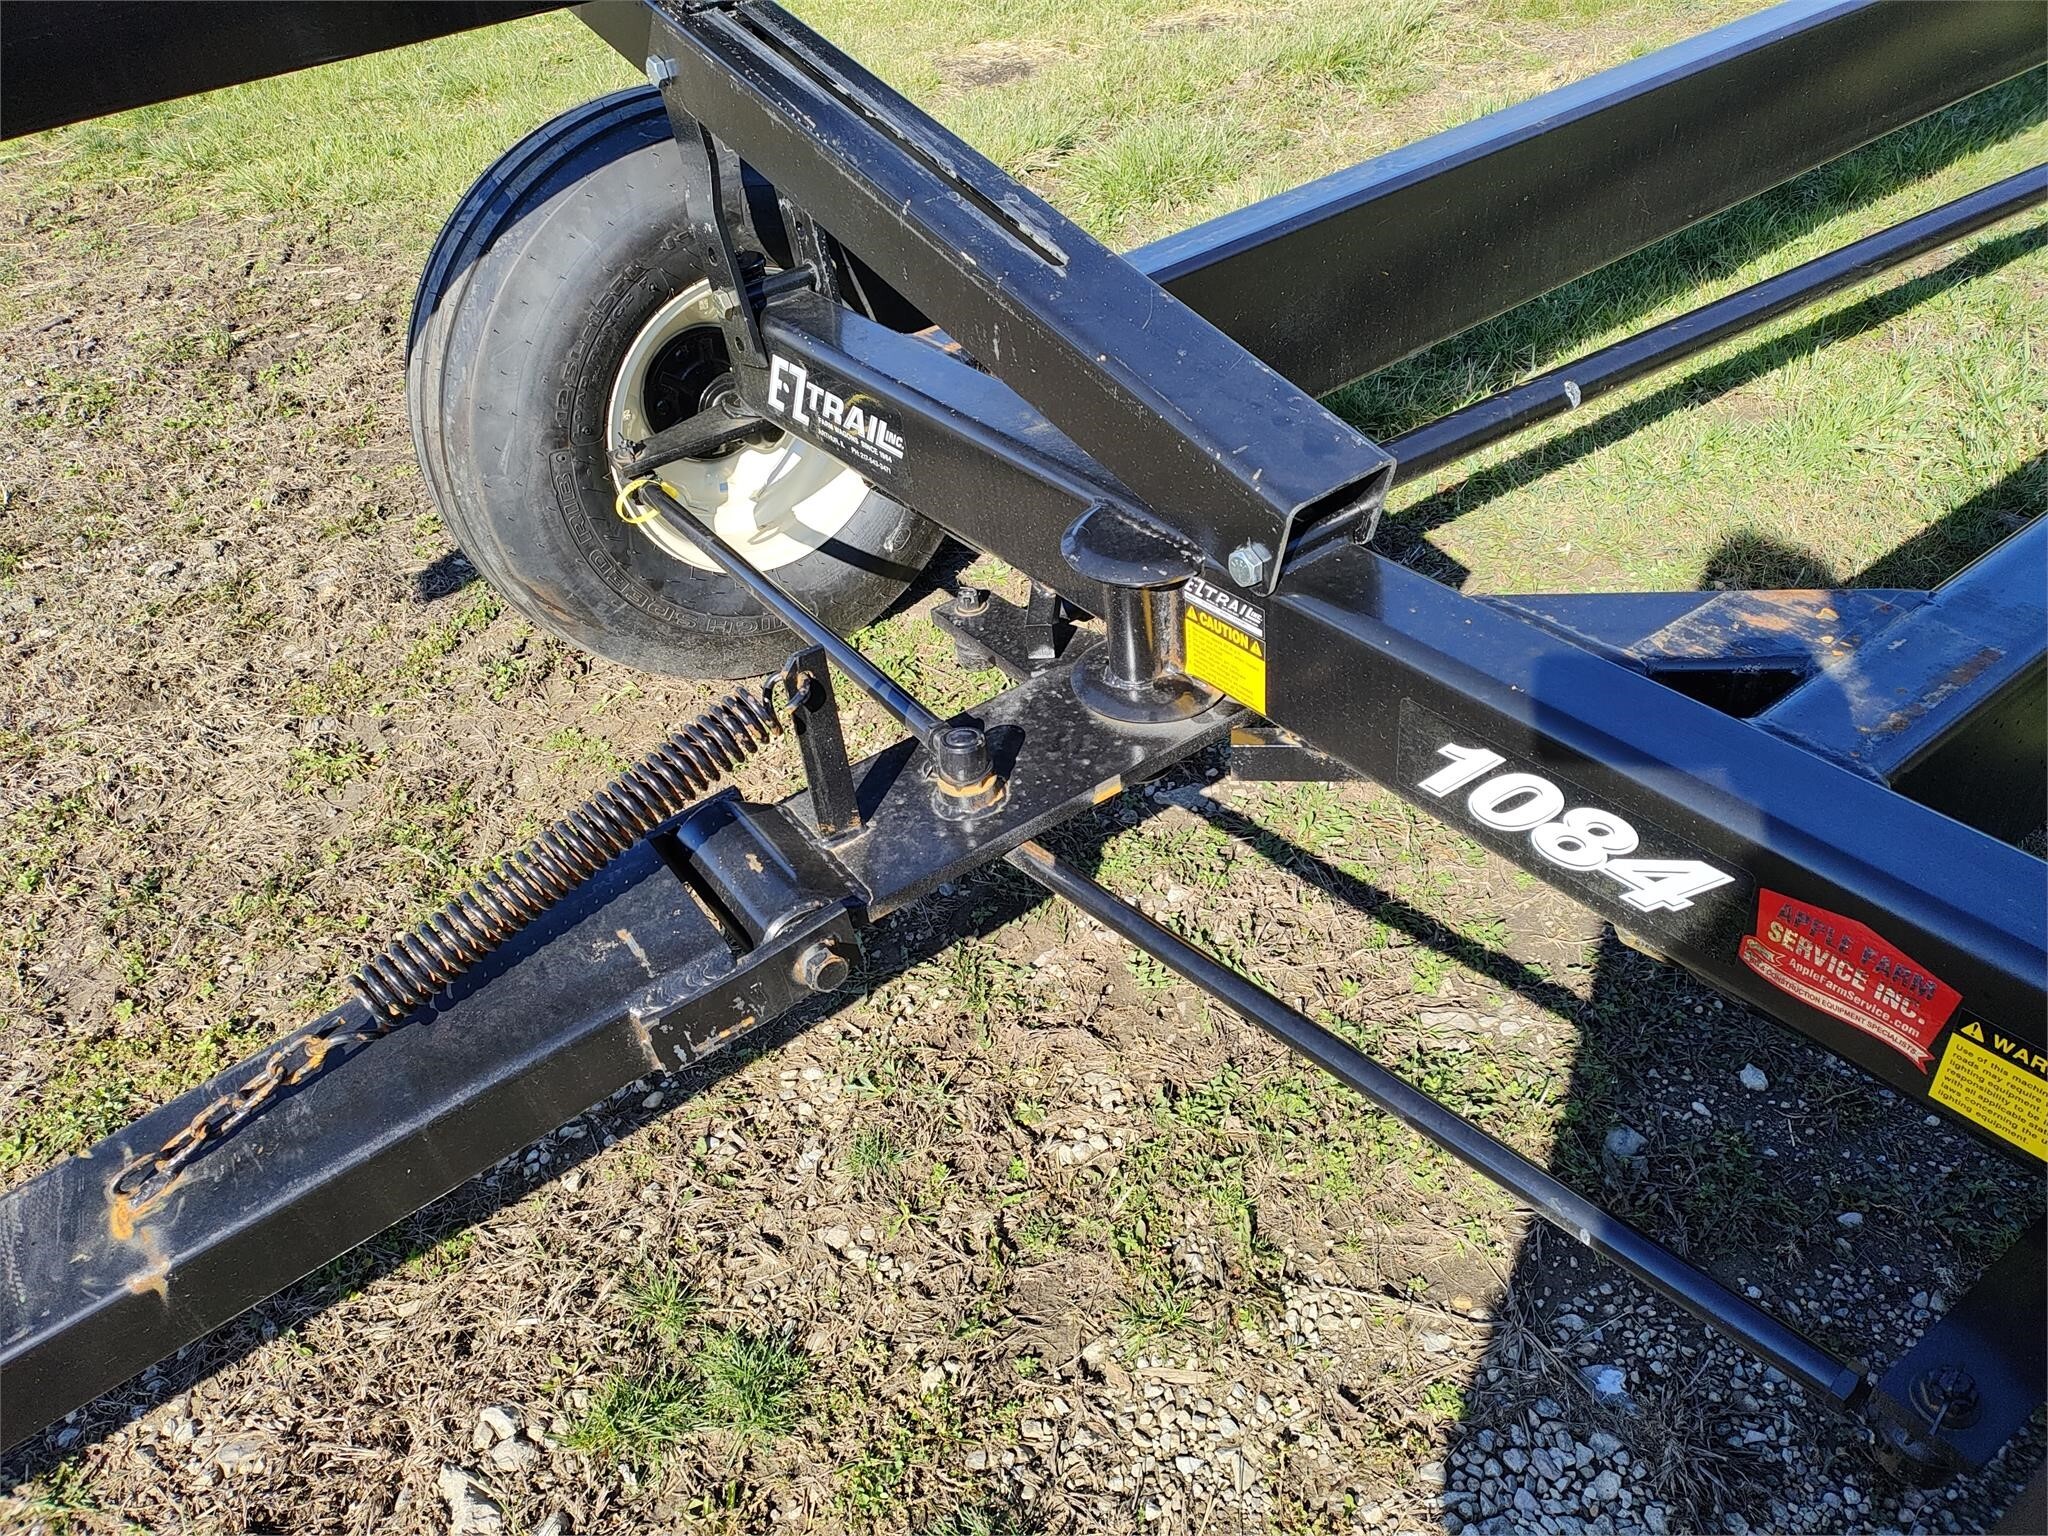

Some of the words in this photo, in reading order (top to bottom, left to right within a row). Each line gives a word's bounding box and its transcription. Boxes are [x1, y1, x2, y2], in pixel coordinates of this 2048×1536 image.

[556, 472, 593, 545] RIB
[589, 549, 699, 628] SPEED
[1200, 611, 1249, 650] CAUTION
[1417, 742, 1736, 913] 1084
[1767, 920, 1870, 992] SERVICE
[1873, 981, 1926, 1025] INC.
[1776, 903, 1854, 954] APPLE
[1860, 945, 1938, 1000] FARM
[1766, 968, 1821, 1004] CONSTRUCTION
[1821, 997, 1866, 1024] EQUIPMENT
[1866, 1020, 1917, 1055] SPECIALISTS
[1789, 957, 1921, 1039] AppleFarmService.com
[1949, 1059, 1985, 1084] lighting
[1987, 1081, 2043, 1114] equipment.
[1952, 1052, 1979, 1071] roads
[1982, 1068, 2004, 1083] may
[2006, 1081, 2042, 1104] require
[1956, 1044, 1974, 1057] Use
[1977, 1056, 1988, 1065] of
[1990, 1062, 2009, 1077] this
[1937, 1089, 1973, 1113] lighting
[1975, 1112, 2029, 1145] equipment.
[1941, 1082, 1962, 1098] laws
[1964, 1096, 2018, 1130] concerning
[2021, 1126, 2038, 1140] the
[1944, 1075, 1964, 1089] with
[1964, 1087, 1977, 1096] all
[1977, 1094, 2027, 1124] applicable
[2028, 1121, 2048, 1137] stat
[1946, 1068, 2011, 1107] responsibility
[2014, 1103, 2024, 1113] to
[2027, 1111, 2040, 1121] be
